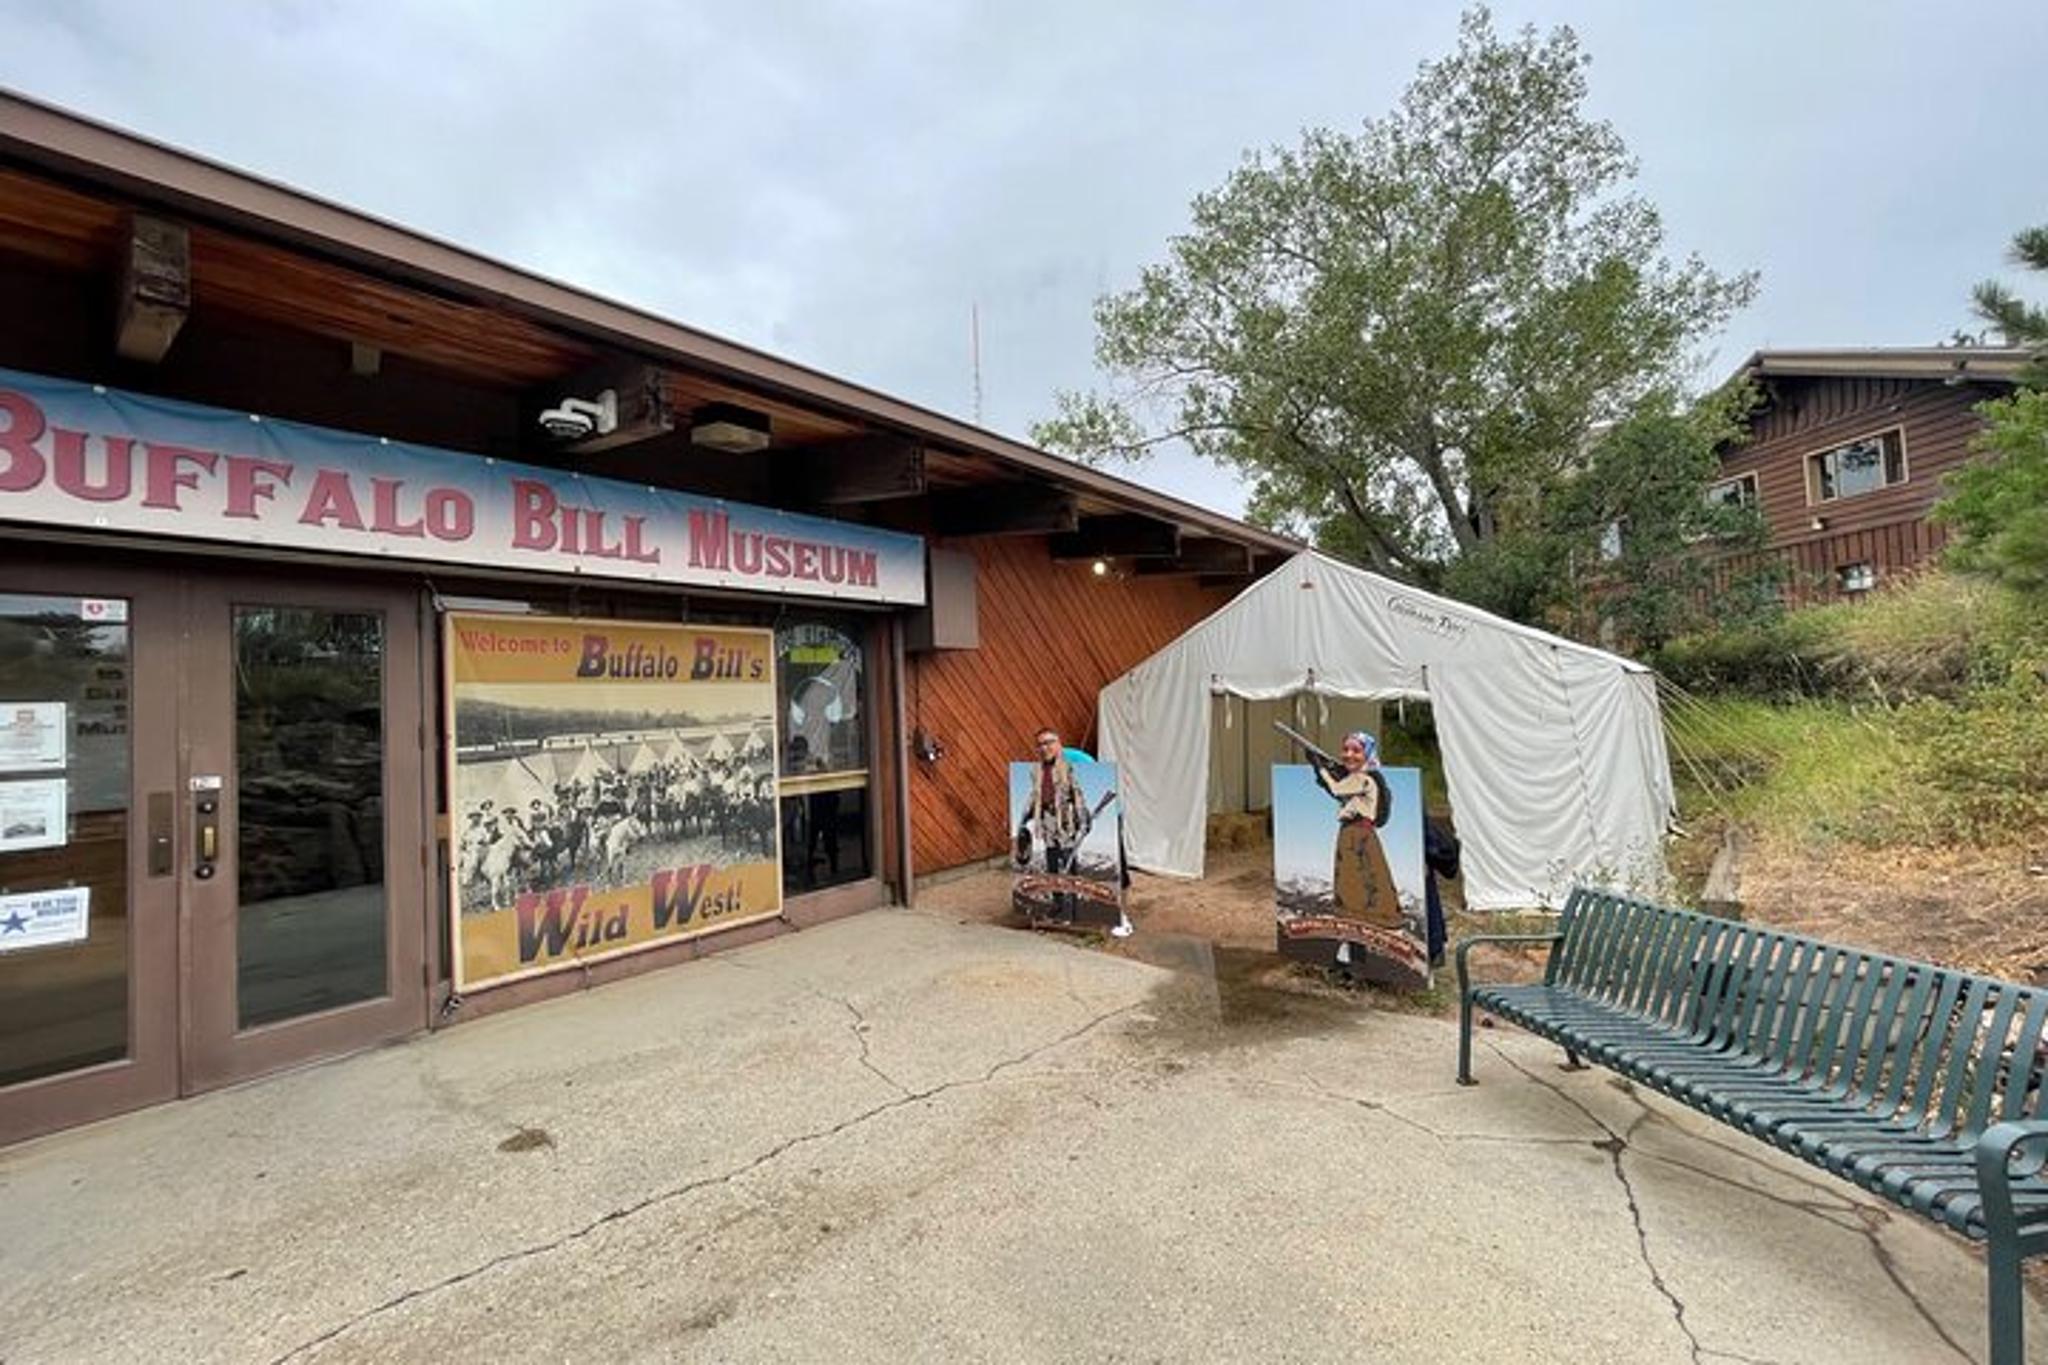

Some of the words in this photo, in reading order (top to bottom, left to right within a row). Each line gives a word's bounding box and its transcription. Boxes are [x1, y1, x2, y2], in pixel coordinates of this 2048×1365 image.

[511, 479, 660, 564] BILL
[688, 508, 878, 588] MUSEUM
[459, 632, 546, 654] Welcome
[553, 636, 571, 654] to
[577, 635, 678, 678] Buffalo
[690, 636, 763, 681] Bill's
[515, 887, 628, 963] Wild
[650, 864, 743, 930] West!
